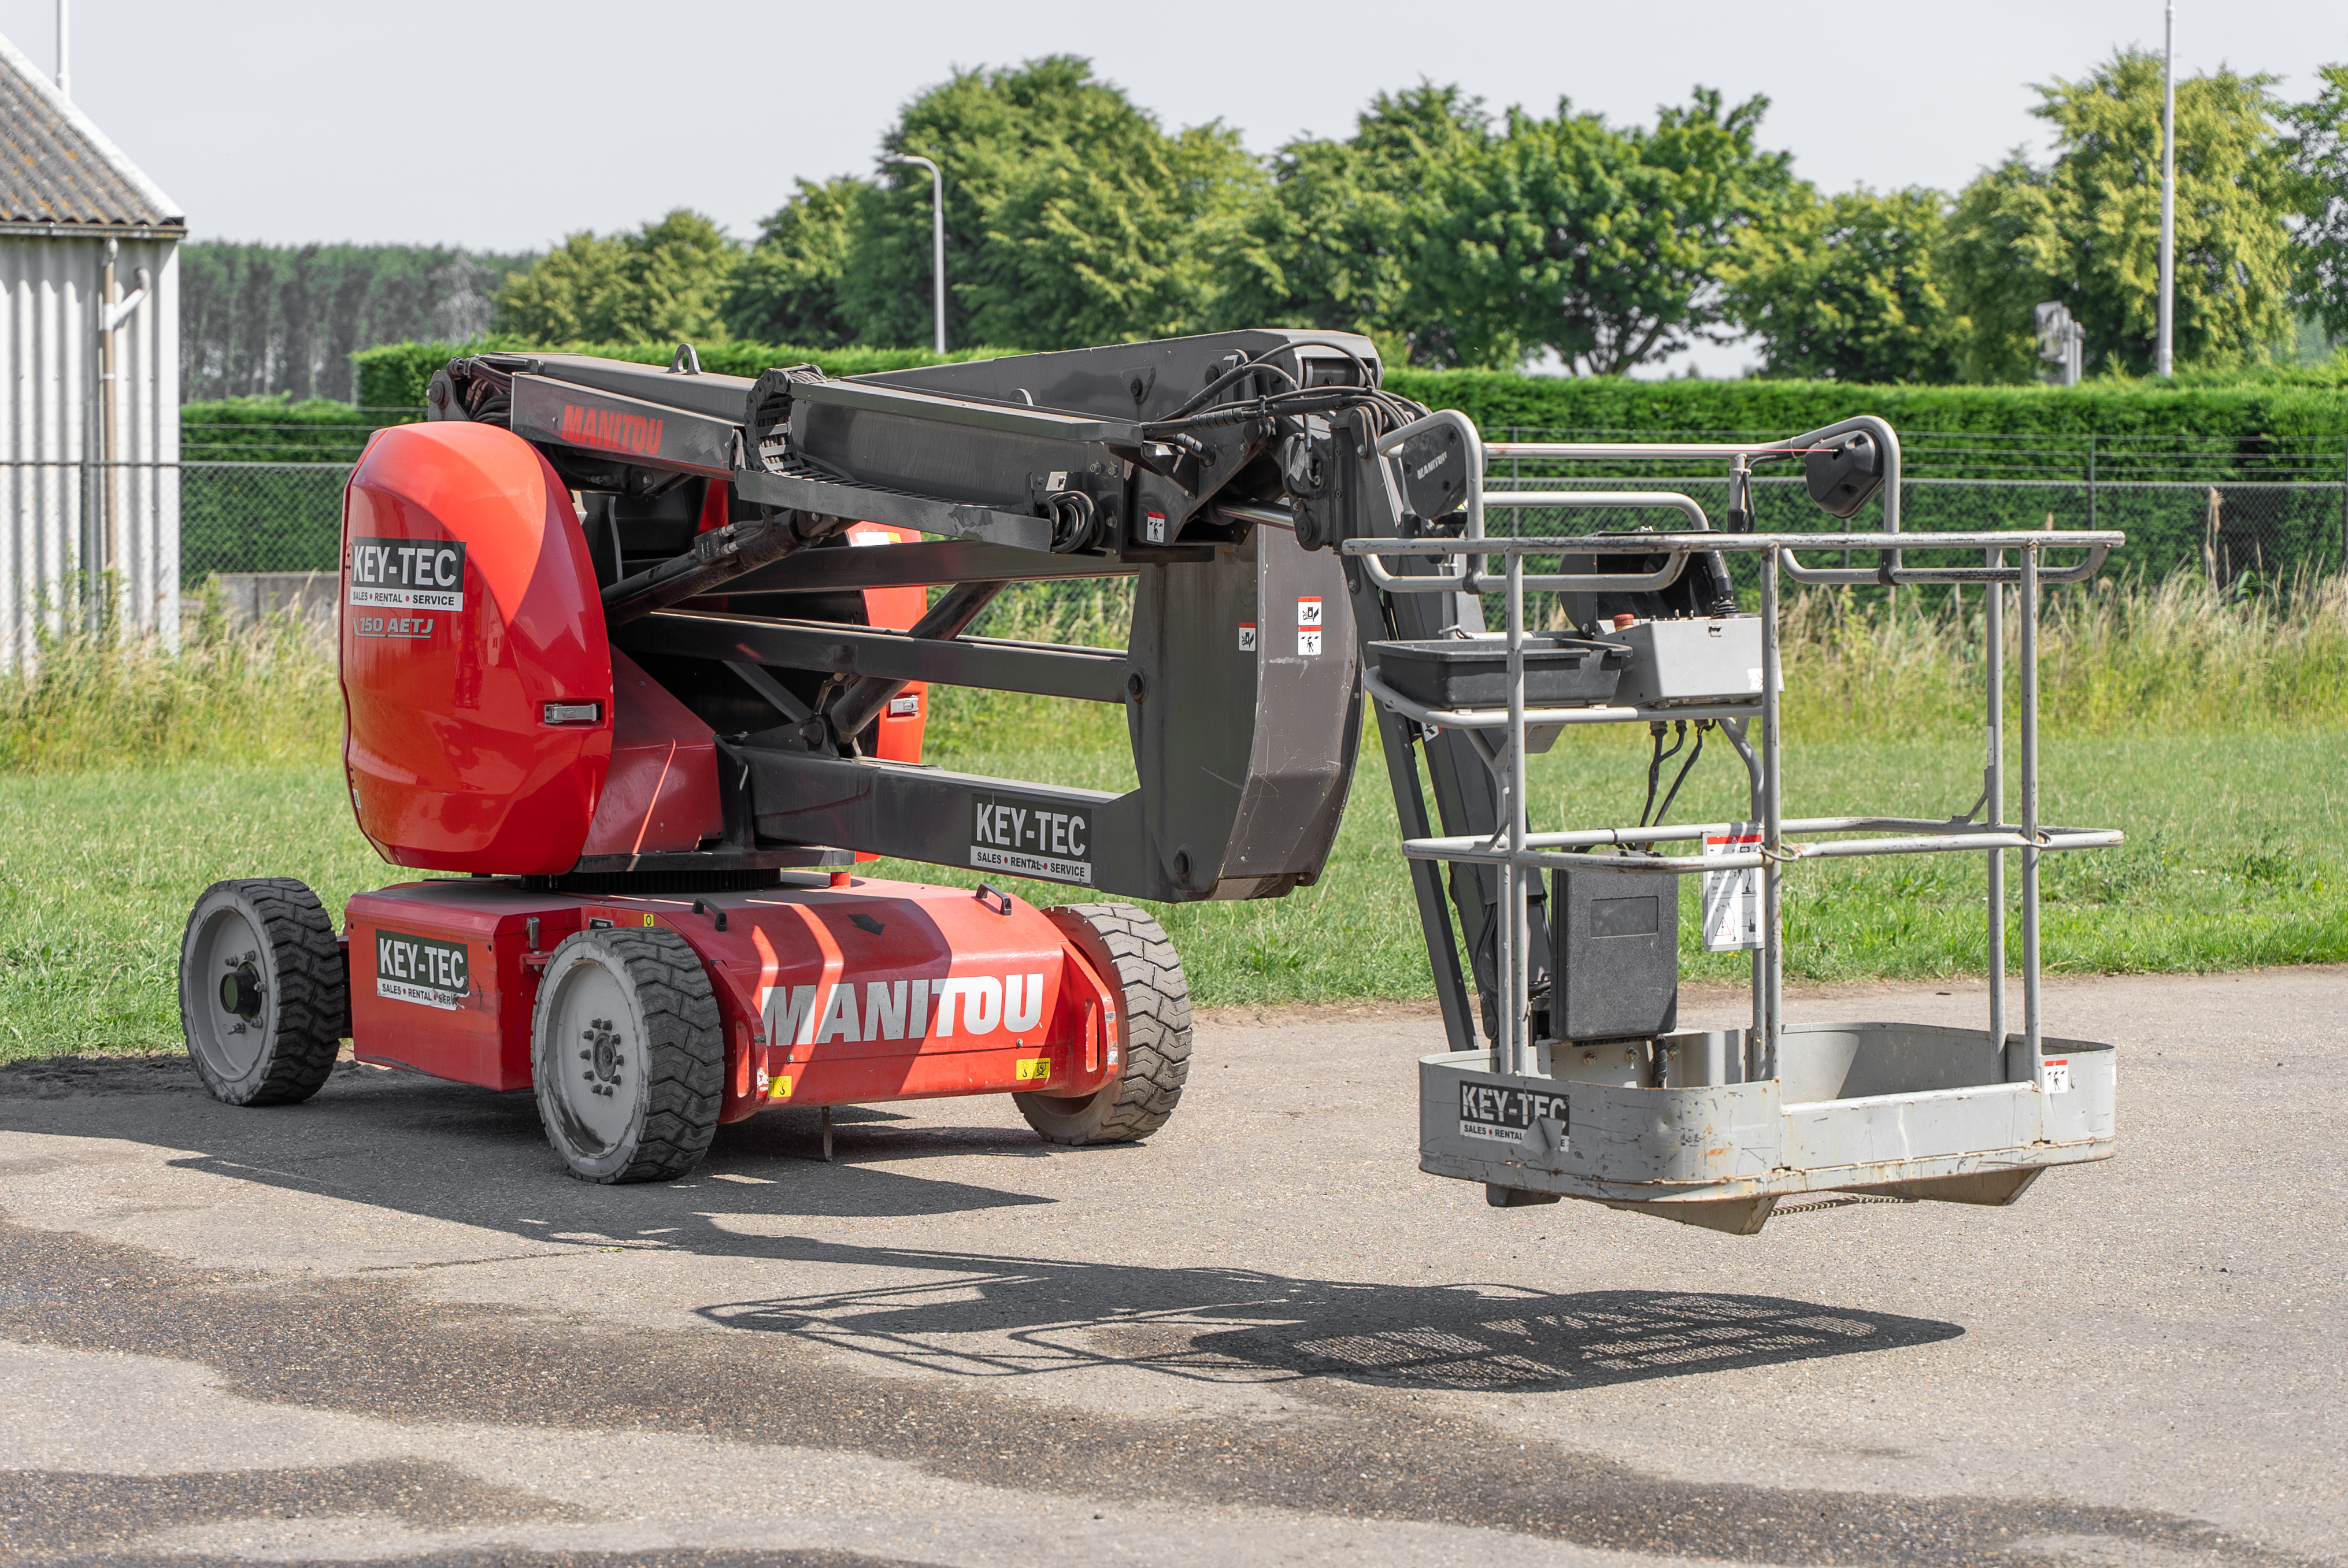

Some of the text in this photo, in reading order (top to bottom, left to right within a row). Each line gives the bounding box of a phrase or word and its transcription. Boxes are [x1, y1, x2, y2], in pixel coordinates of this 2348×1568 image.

[561, 405, 664, 455] MANITOU
[1417, 451, 1447, 480] MANITOU
[353, 546, 457, 587] KEY-TEC
[353, 591, 455, 606] SALES RENTAL SERVICE
[360, 617, 434, 634] 150 AETJ
[976, 803, 1086, 856] KEY-TEC
[977, 851, 1085, 877] SALES RENTAL SERVICE
[379, 937, 465, 988] KEY-TEC
[382, 983, 401, 995] SALES
[408, 988, 432, 1001] RENTAL
[762, 973, 1043, 1046] MANITOU
[1464, 1125, 1523, 1140] SALES RENTAL
